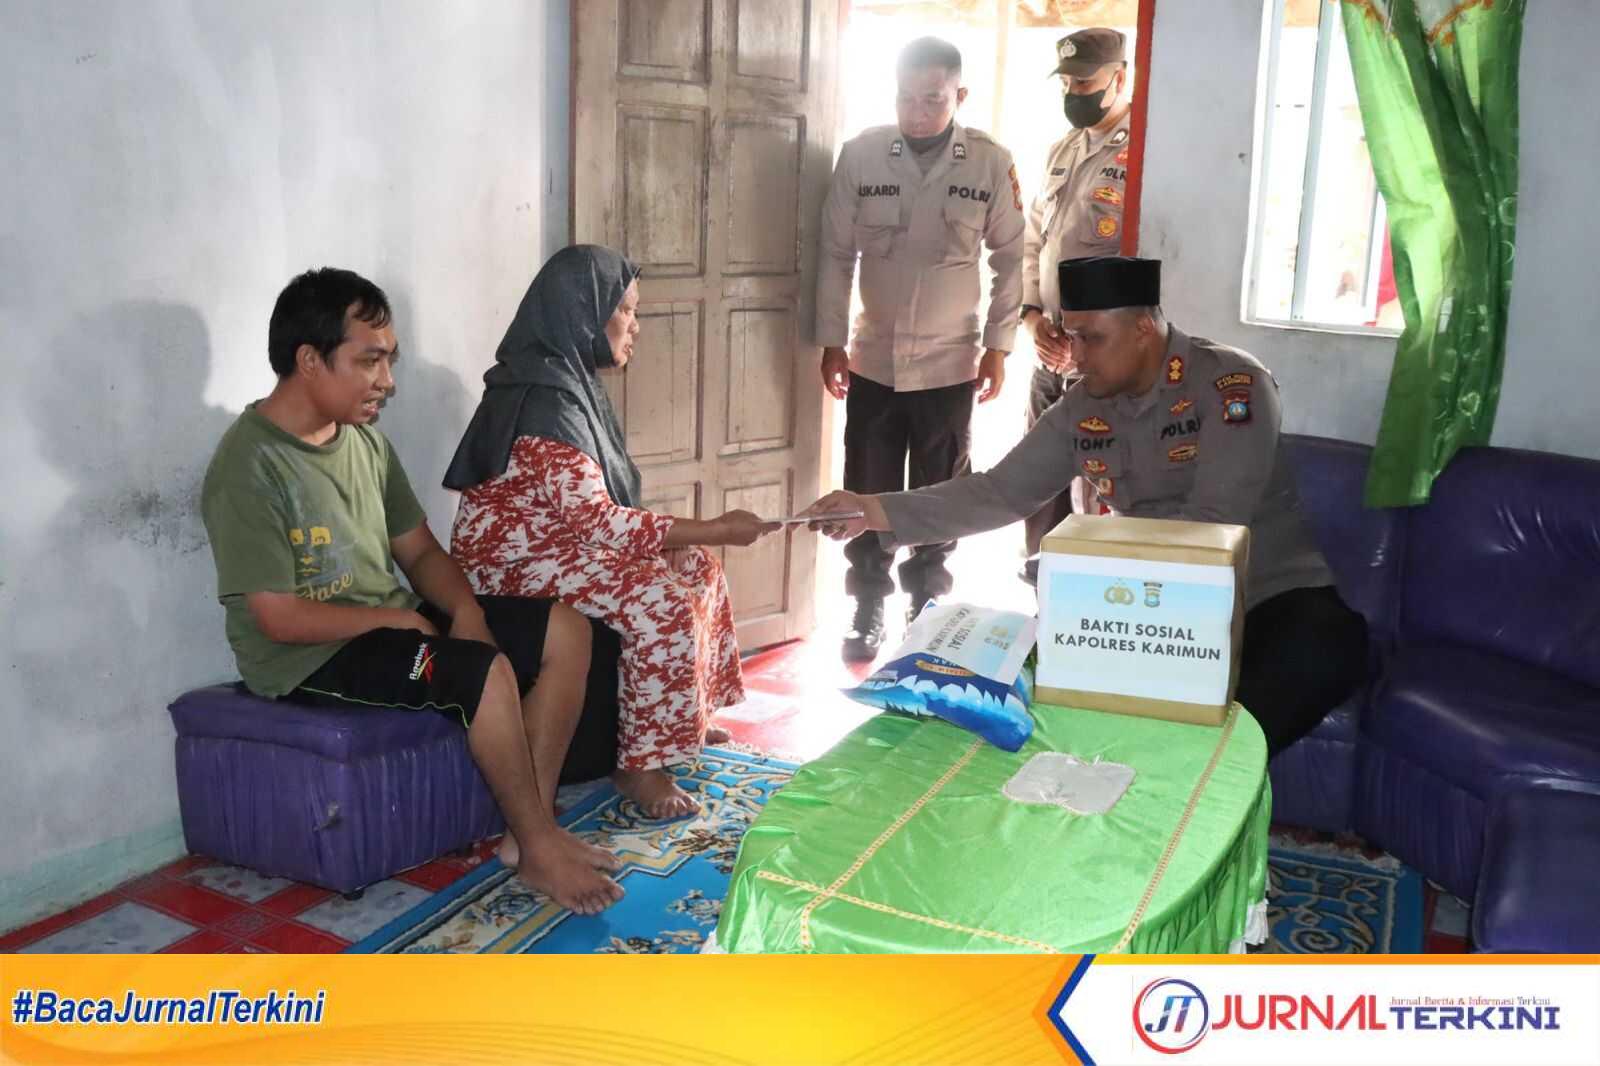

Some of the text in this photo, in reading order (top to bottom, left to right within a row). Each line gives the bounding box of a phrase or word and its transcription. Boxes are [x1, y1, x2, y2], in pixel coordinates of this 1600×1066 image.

[948, 185, 991, 203] POLRI
[1080, 618, 1195, 641] BAKTI SOSIAL
[1054, 633, 1221, 660] KAPOLRES KARIMUN
